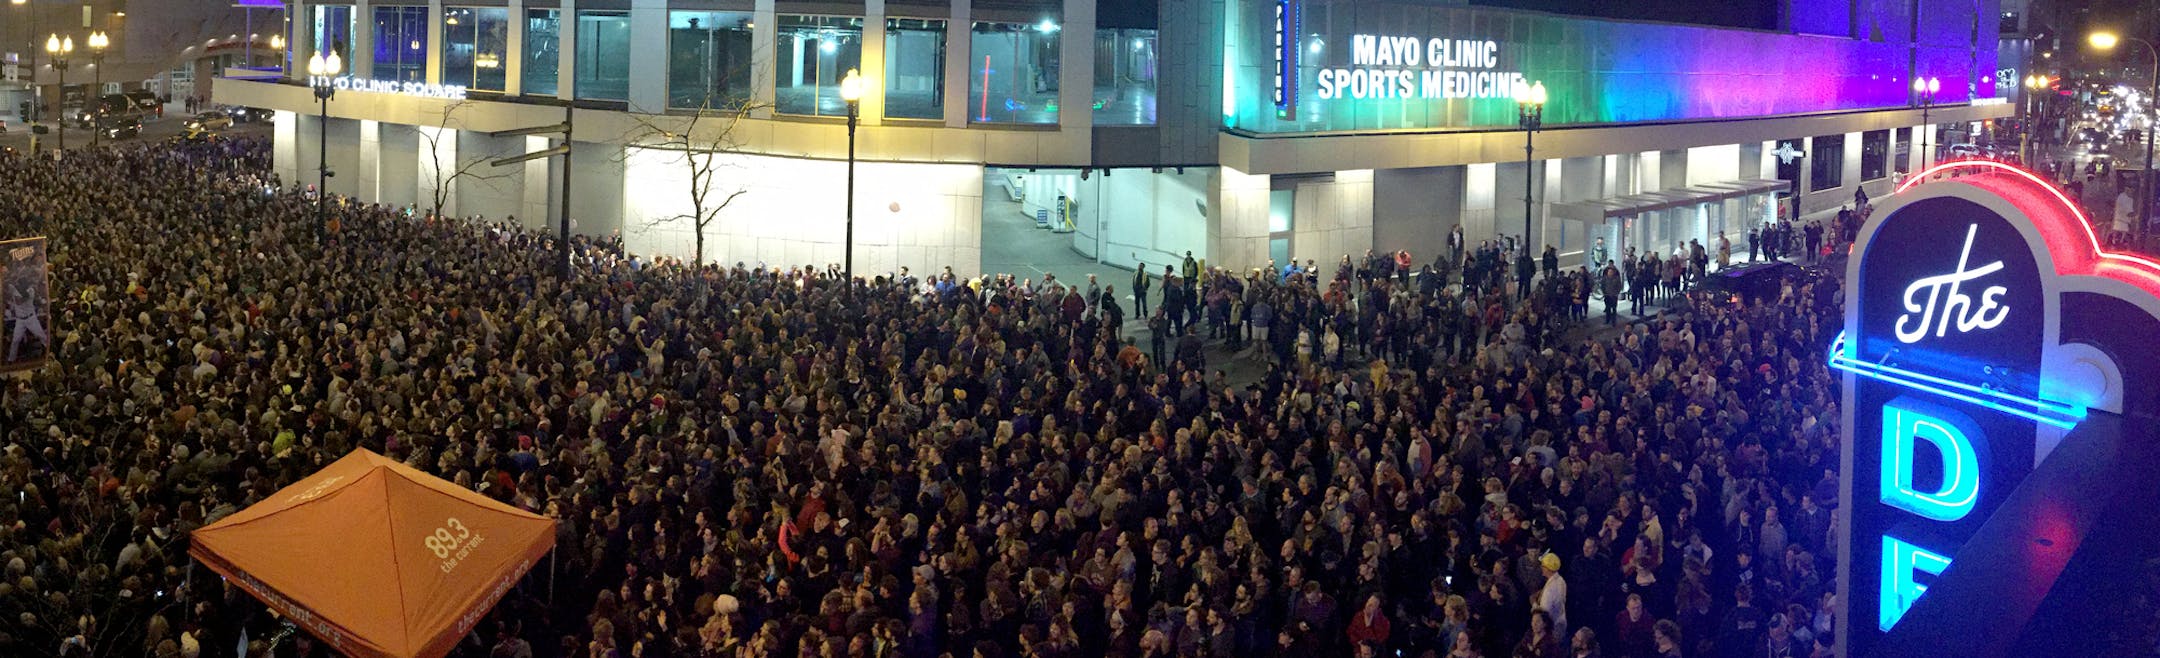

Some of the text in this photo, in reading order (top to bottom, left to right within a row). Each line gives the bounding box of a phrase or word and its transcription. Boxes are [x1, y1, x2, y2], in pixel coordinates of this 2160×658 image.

[1353, 34, 1497, 68] MAYO CLINIC
[352, 78, 400, 95] CLINIC
[403, 82, 467, 99] SQUARE
[1317, 69, 1523, 99] SPORTS MEDICINE
[1895, 223, 2010, 344] The
[424, 517, 470, 559] 89.3
[440, 533, 485, 574] the current
